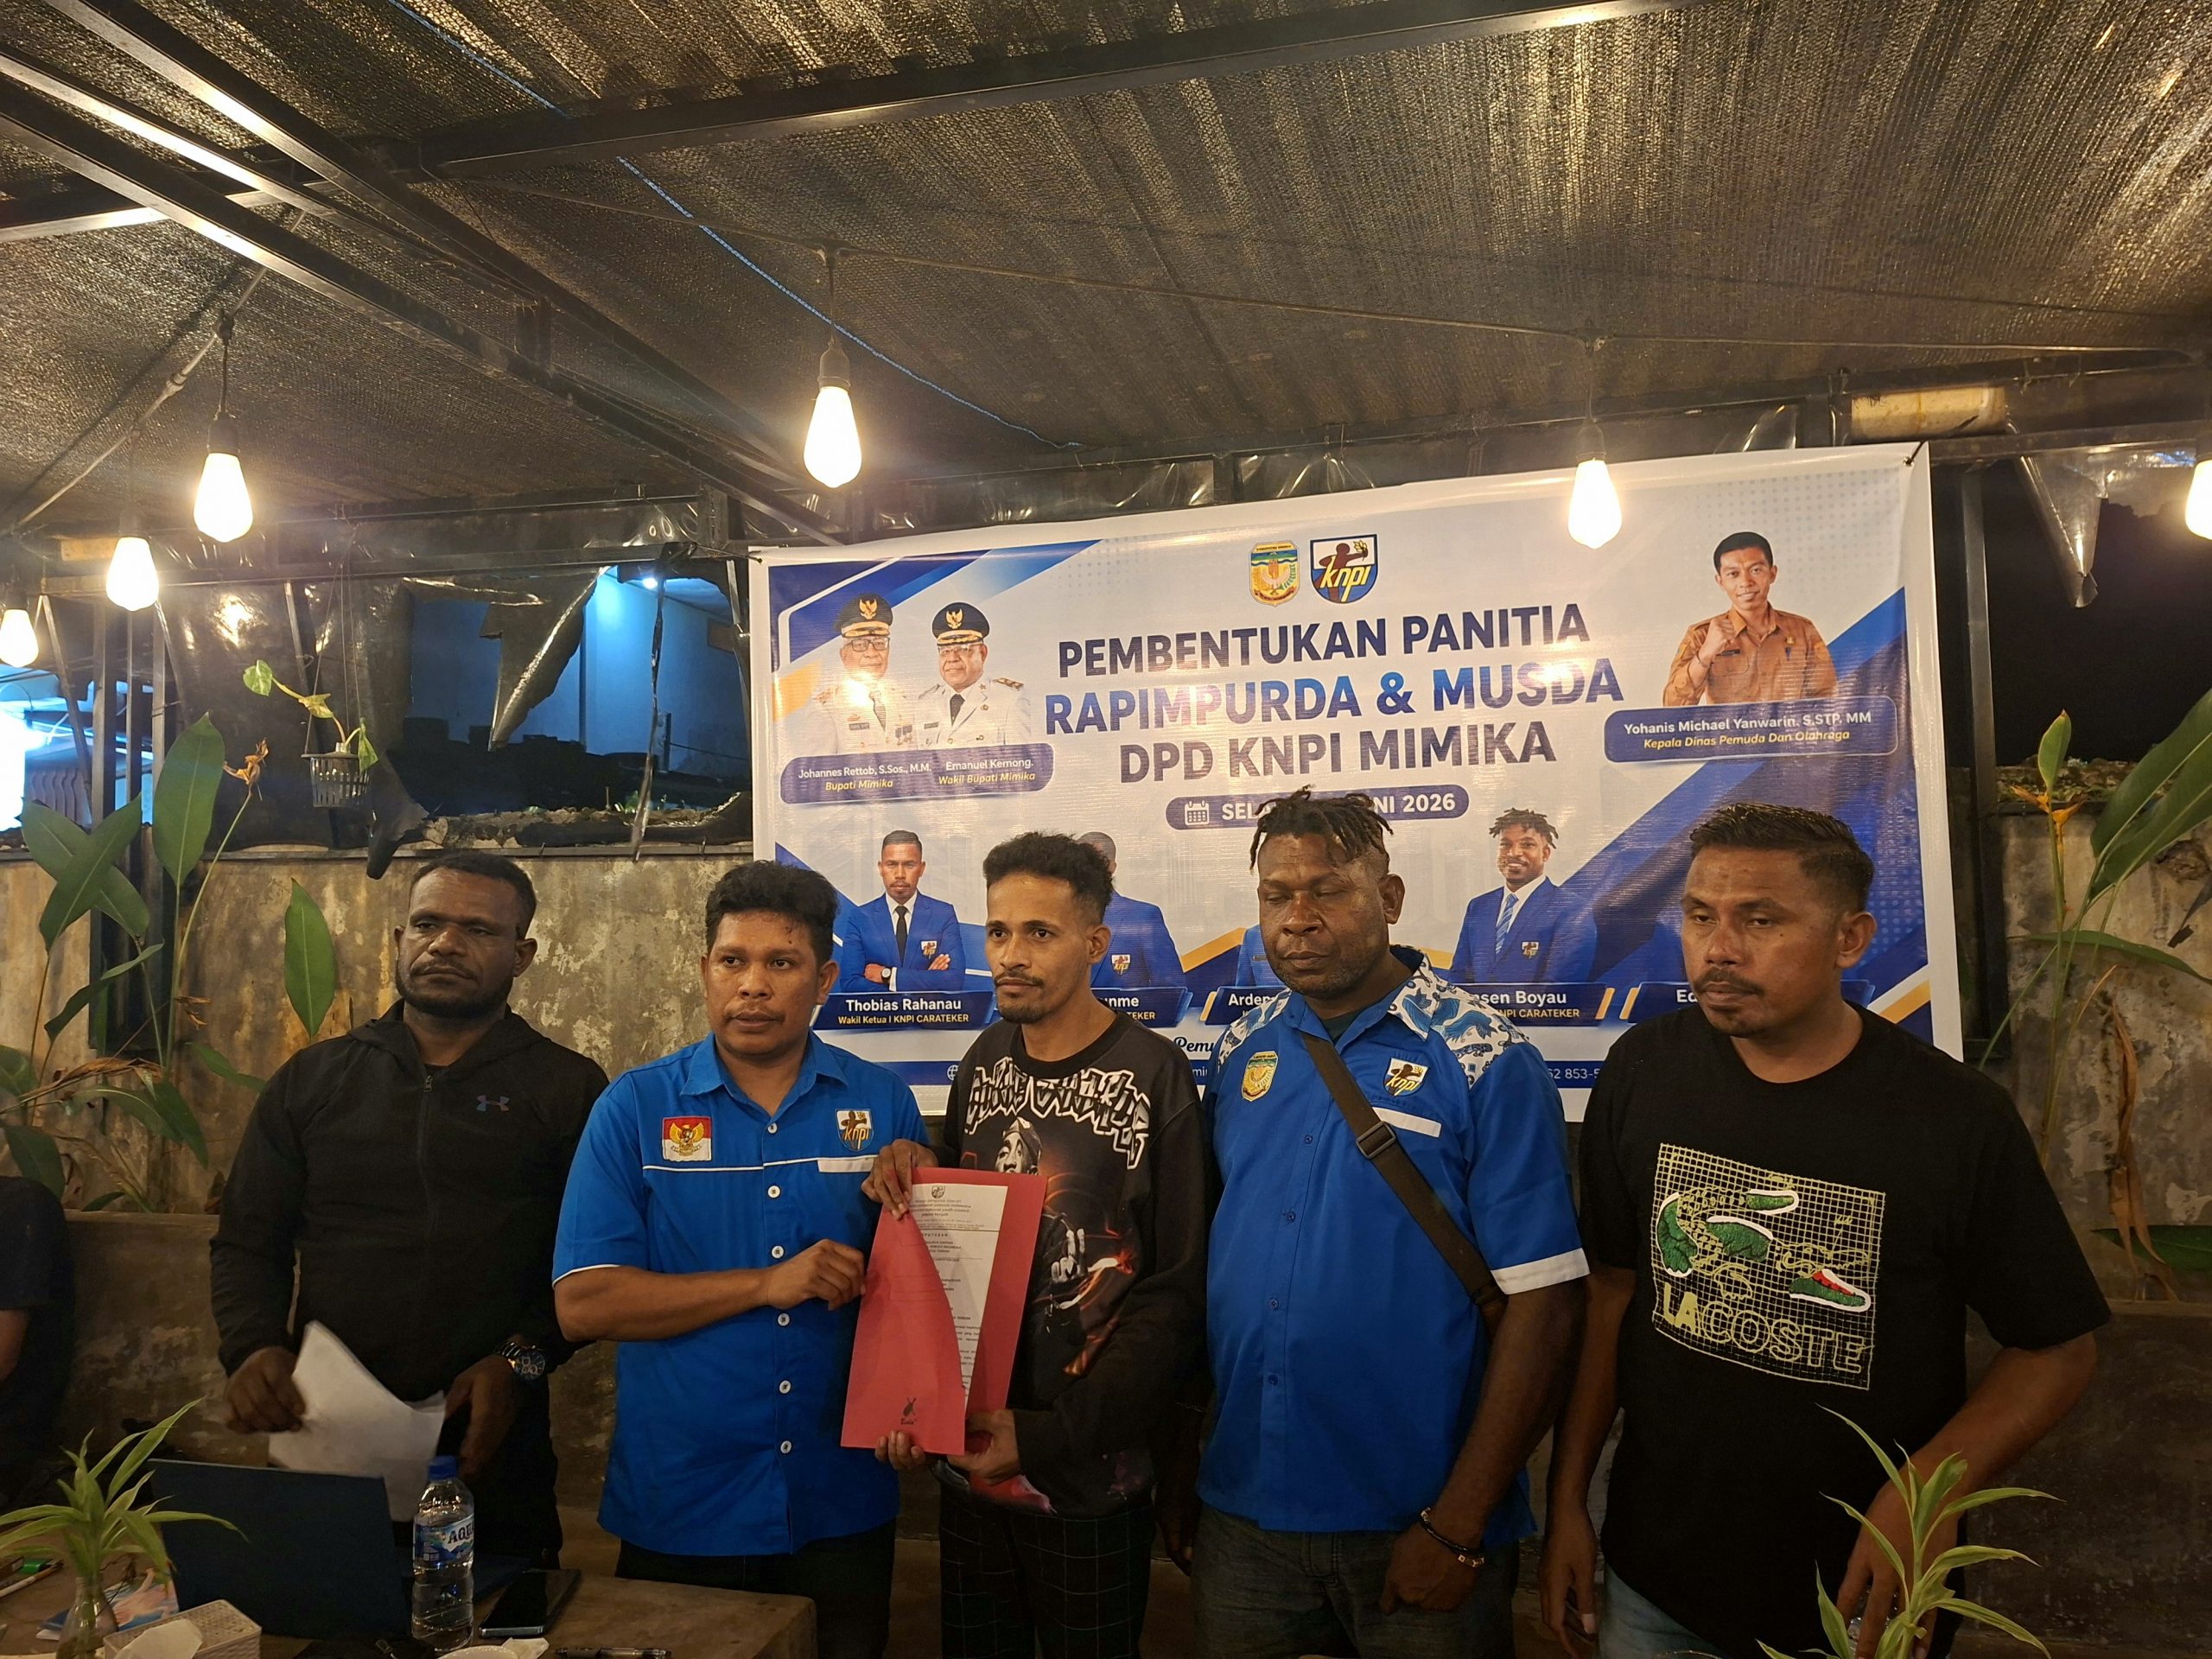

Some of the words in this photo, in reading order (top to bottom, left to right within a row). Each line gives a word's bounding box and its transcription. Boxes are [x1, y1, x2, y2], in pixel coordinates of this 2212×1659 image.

[1319, 556, 1372, 602] knpi
[1058, 617, 1384, 678] PEMBENTUKAN
[1403, 603, 1590, 655] PANITIA
[1046, 675, 1362, 735] RAPIMPURDA
[1376, 671, 1414, 715] &
[1433, 658, 1624, 712] MUSDA
[1624, 721, 1675, 734] Yohanis
[1678, 718, 1730, 732] Michael
[1846, 710, 1872, 724] MM
[1643, 737, 1682, 750] Kepala
[1685, 736, 1716, 747] Dinas
[1719, 733, 1765, 746] Pemuda
[1768, 732, 1792, 742] Dan
[1795, 730, 1850, 743] Olahraga
[1121, 741, 1213, 784] DPD
[1229, 732, 1341, 777] KNPI
[1359, 721, 1556, 772] MIMIKA
[798, 768, 842, 779] Johannes
[945, 760, 988, 771] Emanuel
[825, 780, 856, 792] Bupati
[858, 779, 893, 789] Mimika
[938, 775, 964, 785] Wakil
[967, 772, 998, 784] Bupati
[1000, 771, 1036, 782] Mimika
[1402, 793, 1456, 813] 2026
[846, 999, 899, 1012] Thobias
[902, 998, 962, 1011] Rahanau
[1515, 990, 1567, 1007] Boyau
[837, 1015, 861, 1025] Wakil
[863, 1015, 887, 1025] Ketua
[893, 1014, 915, 1024] KNPI
[916, 1014, 969, 1024] CARATEKER
[1518, 1008, 1580, 1018] CARATEKER
[1385, 1071, 1420, 1096] knpi
[844, 1125, 870, 1150] knpi
[1663, 1282, 1866, 1374] LACOSTE
[448, 1522, 474, 1544] AQU
